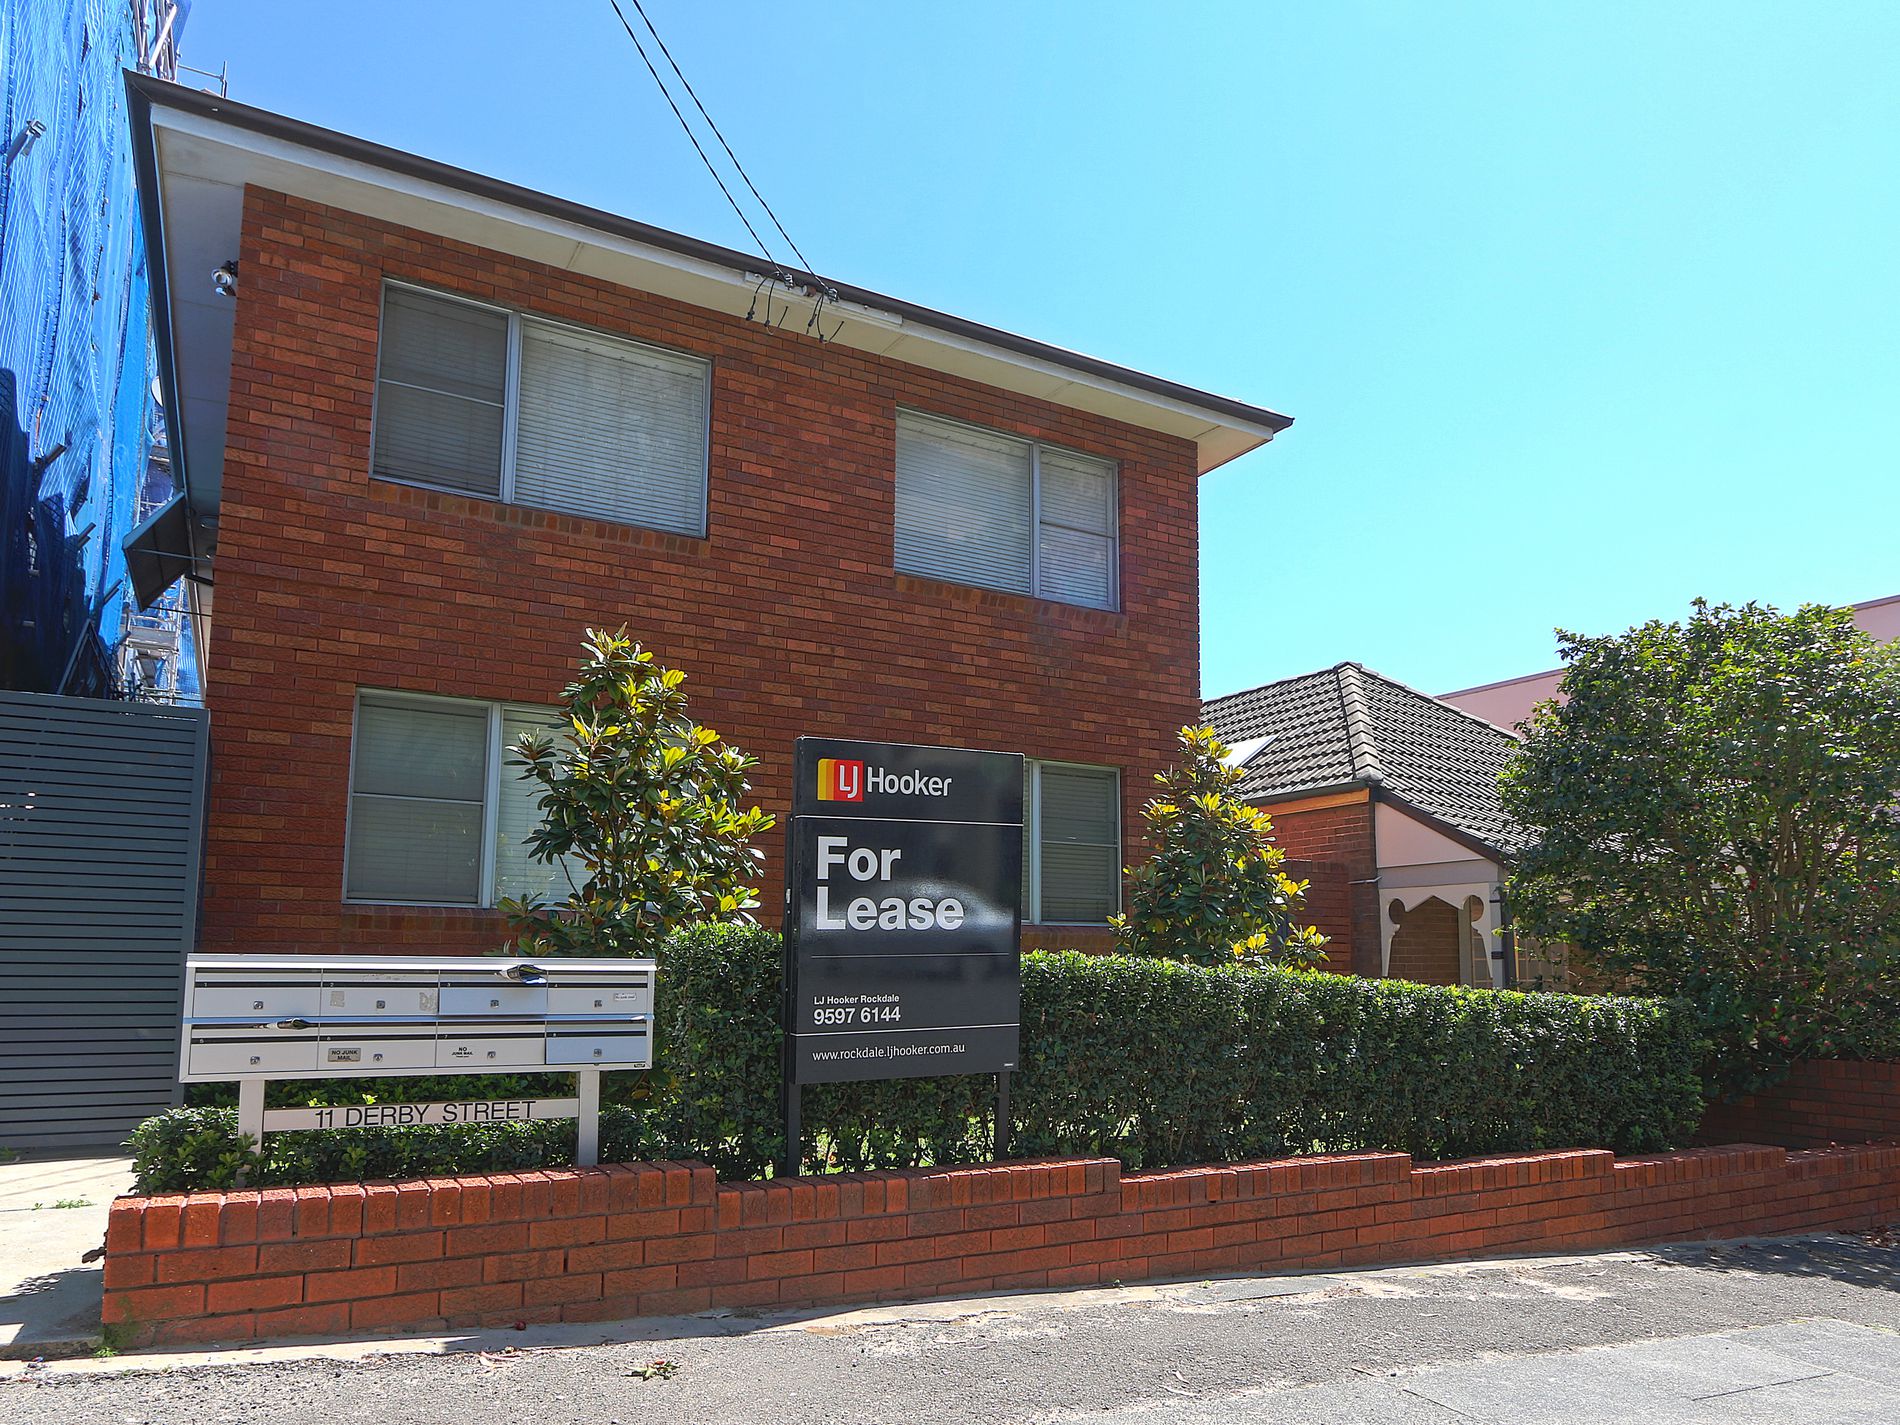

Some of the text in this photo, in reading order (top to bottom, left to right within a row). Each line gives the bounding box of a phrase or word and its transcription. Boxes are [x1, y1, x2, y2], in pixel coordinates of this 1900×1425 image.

[839, 765, 952, 798] LJ Hooker
[817, 835, 901, 881] For
[816, 886, 964, 931] Lease
[814, 994, 900, 1005] LJ Hooker Rockdale
[813, 1006, 901, 1025] 9597 6144
[812, 1042, 966, 1061] www.rockdale.ljhooker.com.au
[315, 1100, 537, 1128] 11 DERBY STREET
